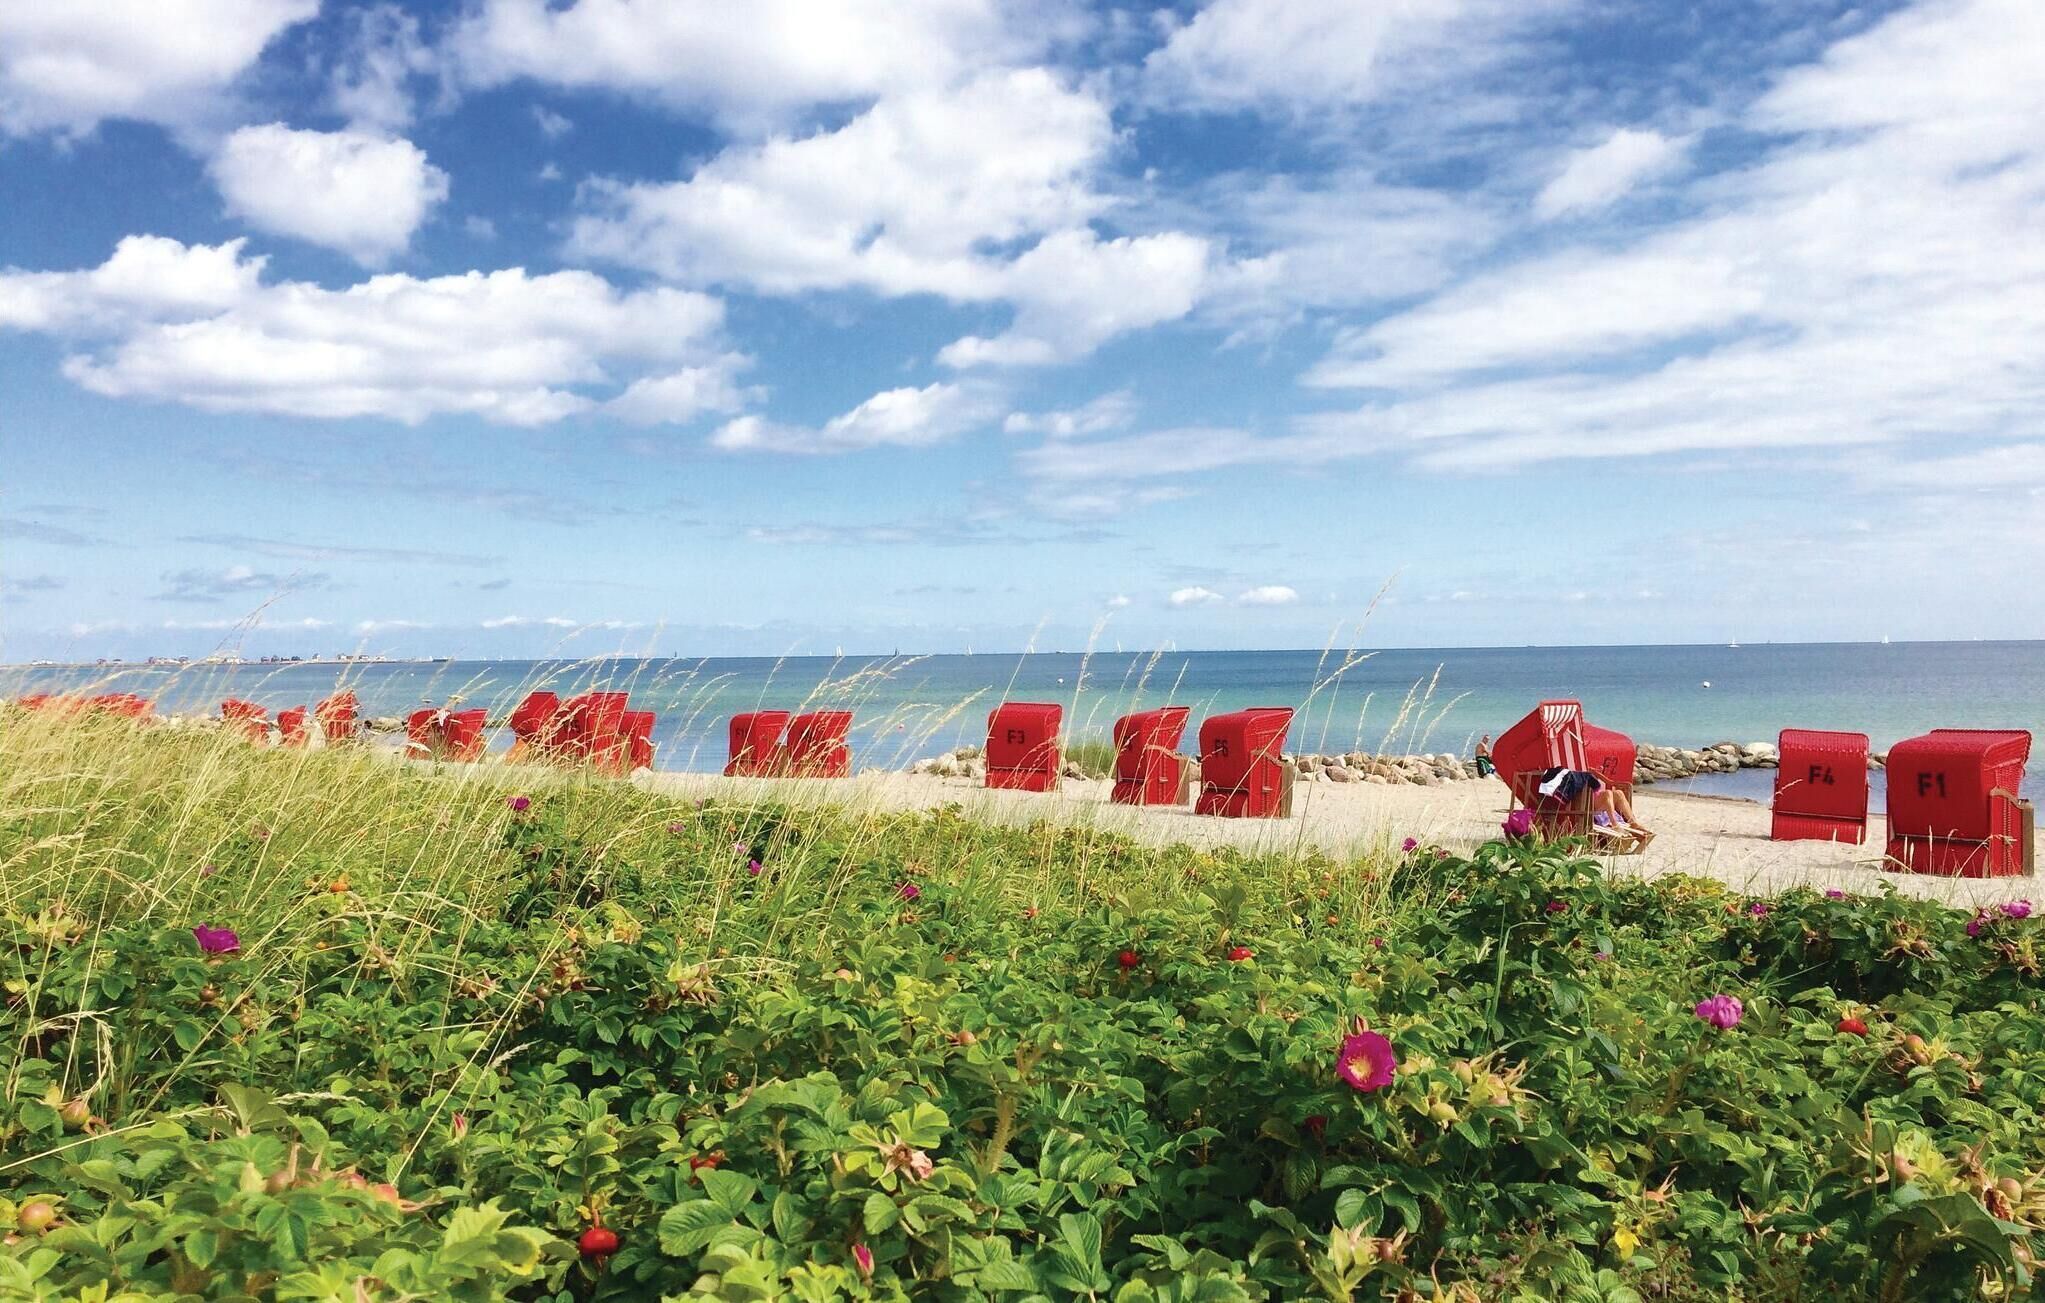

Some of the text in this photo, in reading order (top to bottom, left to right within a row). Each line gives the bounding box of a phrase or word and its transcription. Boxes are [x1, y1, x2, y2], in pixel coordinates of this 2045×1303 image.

[1007, 729, 1025, 745] F3
[1809, 764, 1835, 786] F4
[1917, 771, 1946, 799] F1
